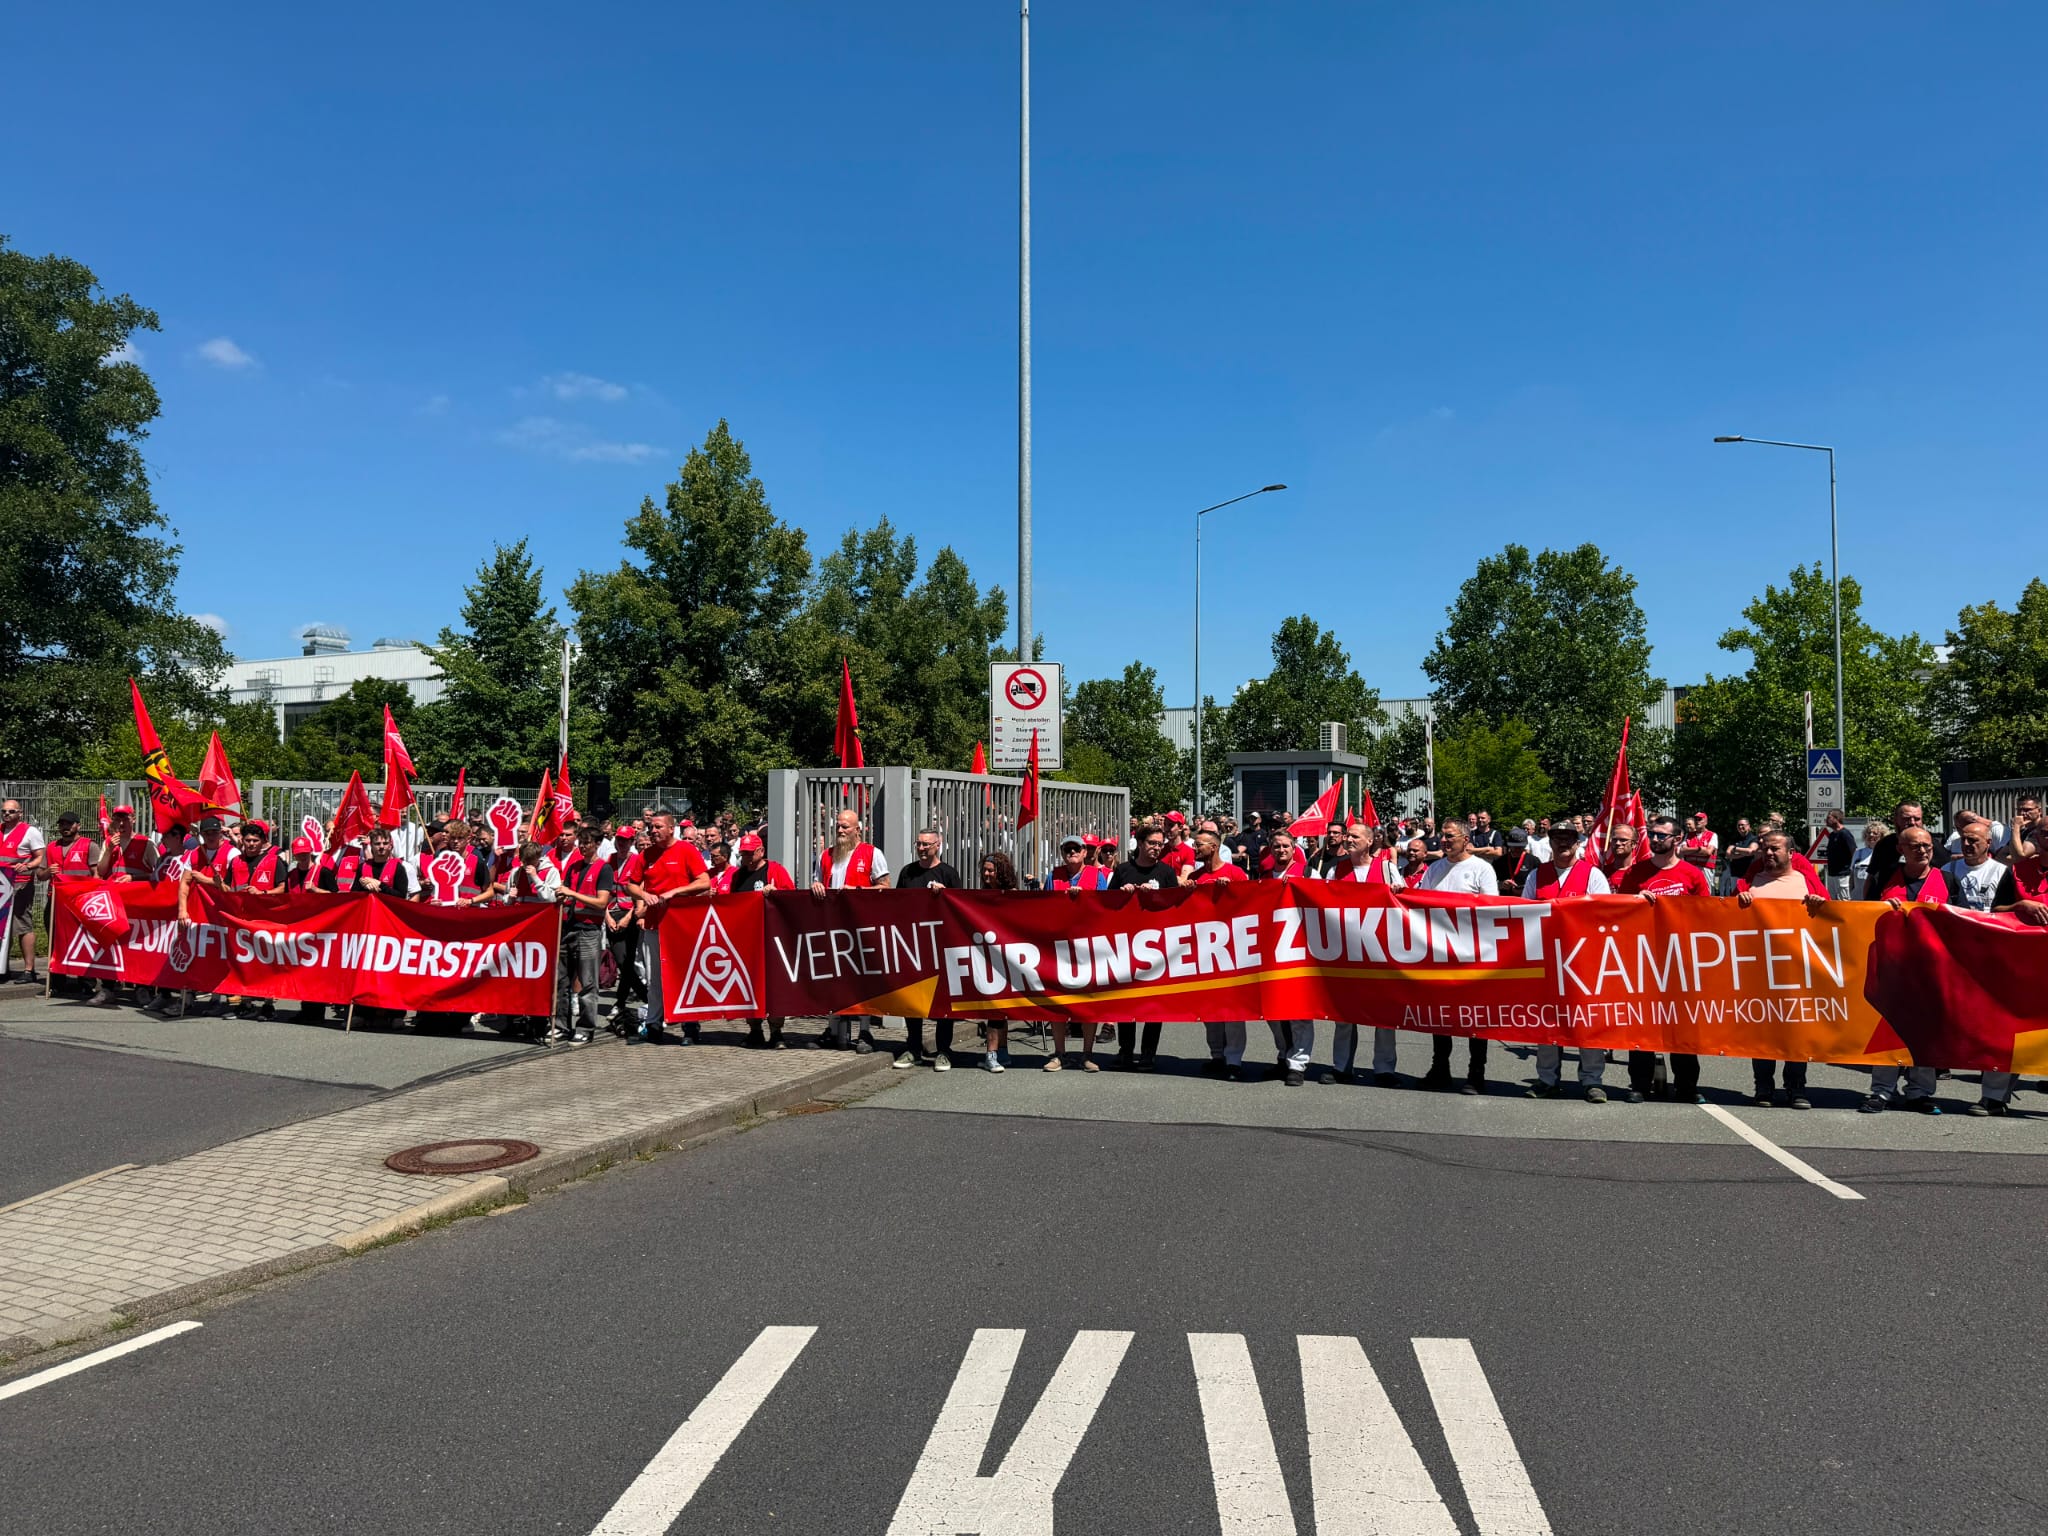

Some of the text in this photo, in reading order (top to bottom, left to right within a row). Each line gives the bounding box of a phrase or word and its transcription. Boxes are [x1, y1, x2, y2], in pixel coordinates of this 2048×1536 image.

[1818, 787, 1832, 796] 30
[235, 929, 337, 967] SONST
[341, 933, 548, 979] WIDERSTAND
[774, 903, 1845, 996] VEREINT FÜR UNSERE ZUKUNFT KÄMPFEN
[1402, 996, 1849, 1028] ALLE BELEGSCHAFTEN IM VW-KONZERN
